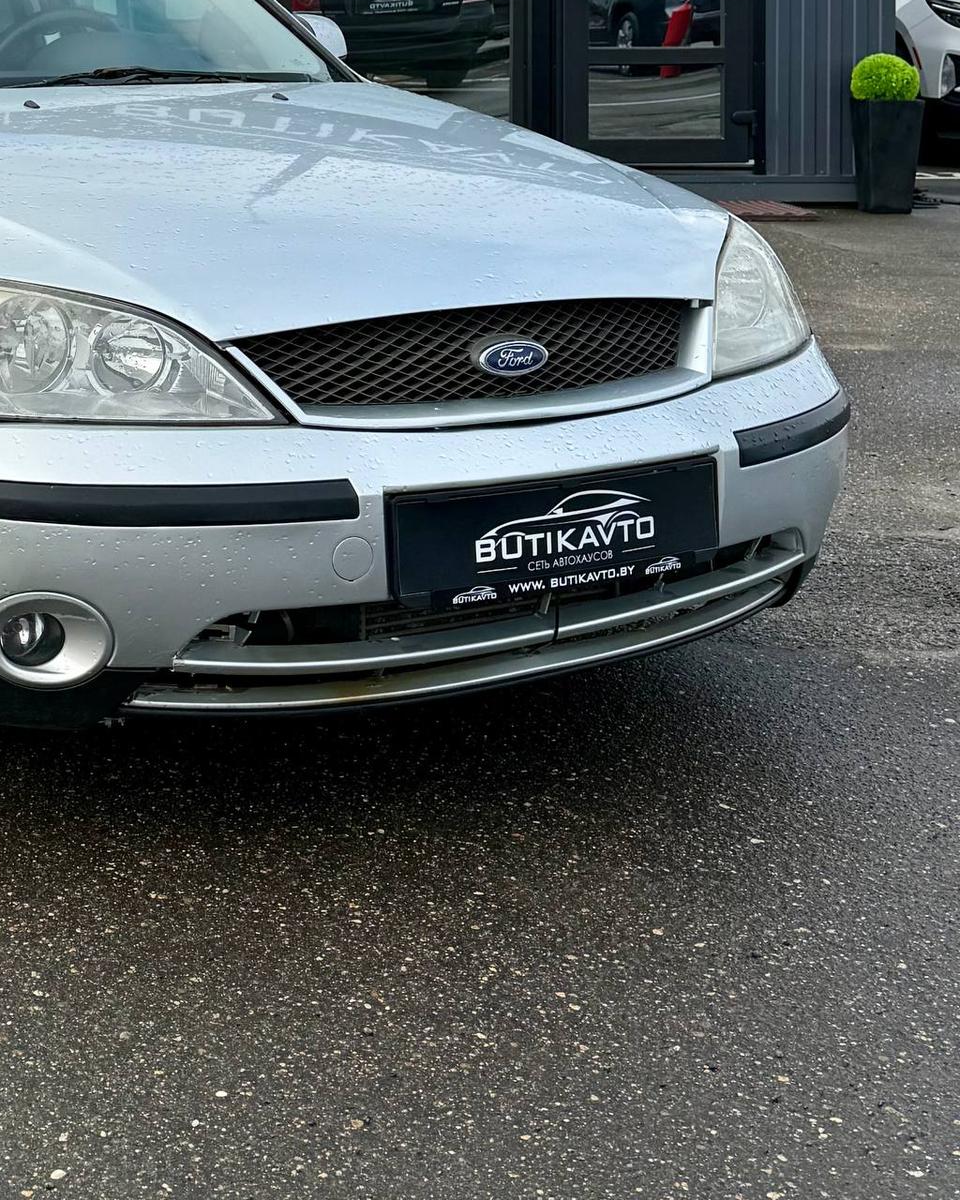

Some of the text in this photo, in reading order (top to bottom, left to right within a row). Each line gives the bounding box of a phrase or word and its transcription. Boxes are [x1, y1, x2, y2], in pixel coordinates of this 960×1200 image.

[498, 348, 533, 368] Ford
[475, 515, 655, 563] BUTIKAVTO
[527, 549, 614, 572] СЕТЬ АВТОХАУСОВ
[645, 562, 682, 575] BUTIKAVTO
[508, 565, 636, 594] WWW. BUTIKAVTO.BY
[452, 592, 497, 605] BUTIKAVTO
